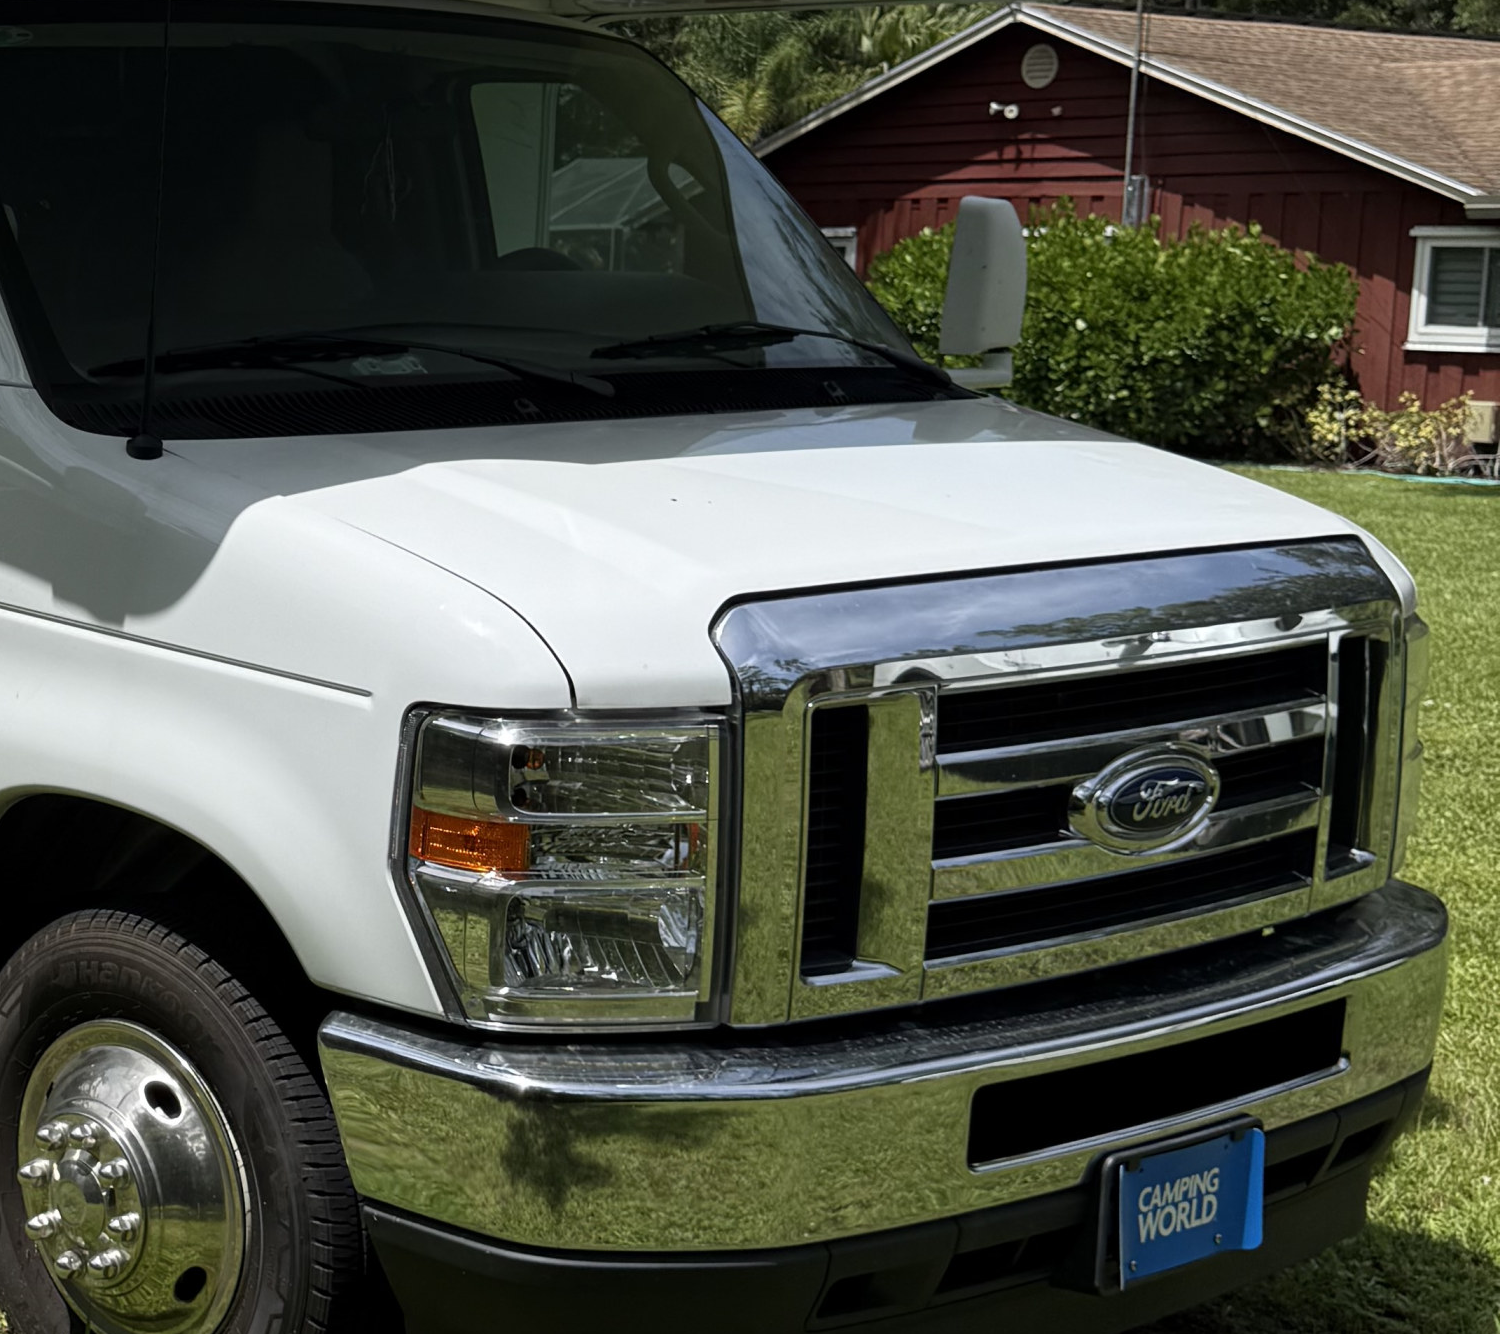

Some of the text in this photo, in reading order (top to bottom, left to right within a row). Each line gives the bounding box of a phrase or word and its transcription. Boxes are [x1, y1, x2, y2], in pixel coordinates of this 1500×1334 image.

[1132, 777, 1206, 822] Ford
[1138, 1166, 1220, 1213] CAMPING
[1137, 1194, 1218, 1244] WORLD
